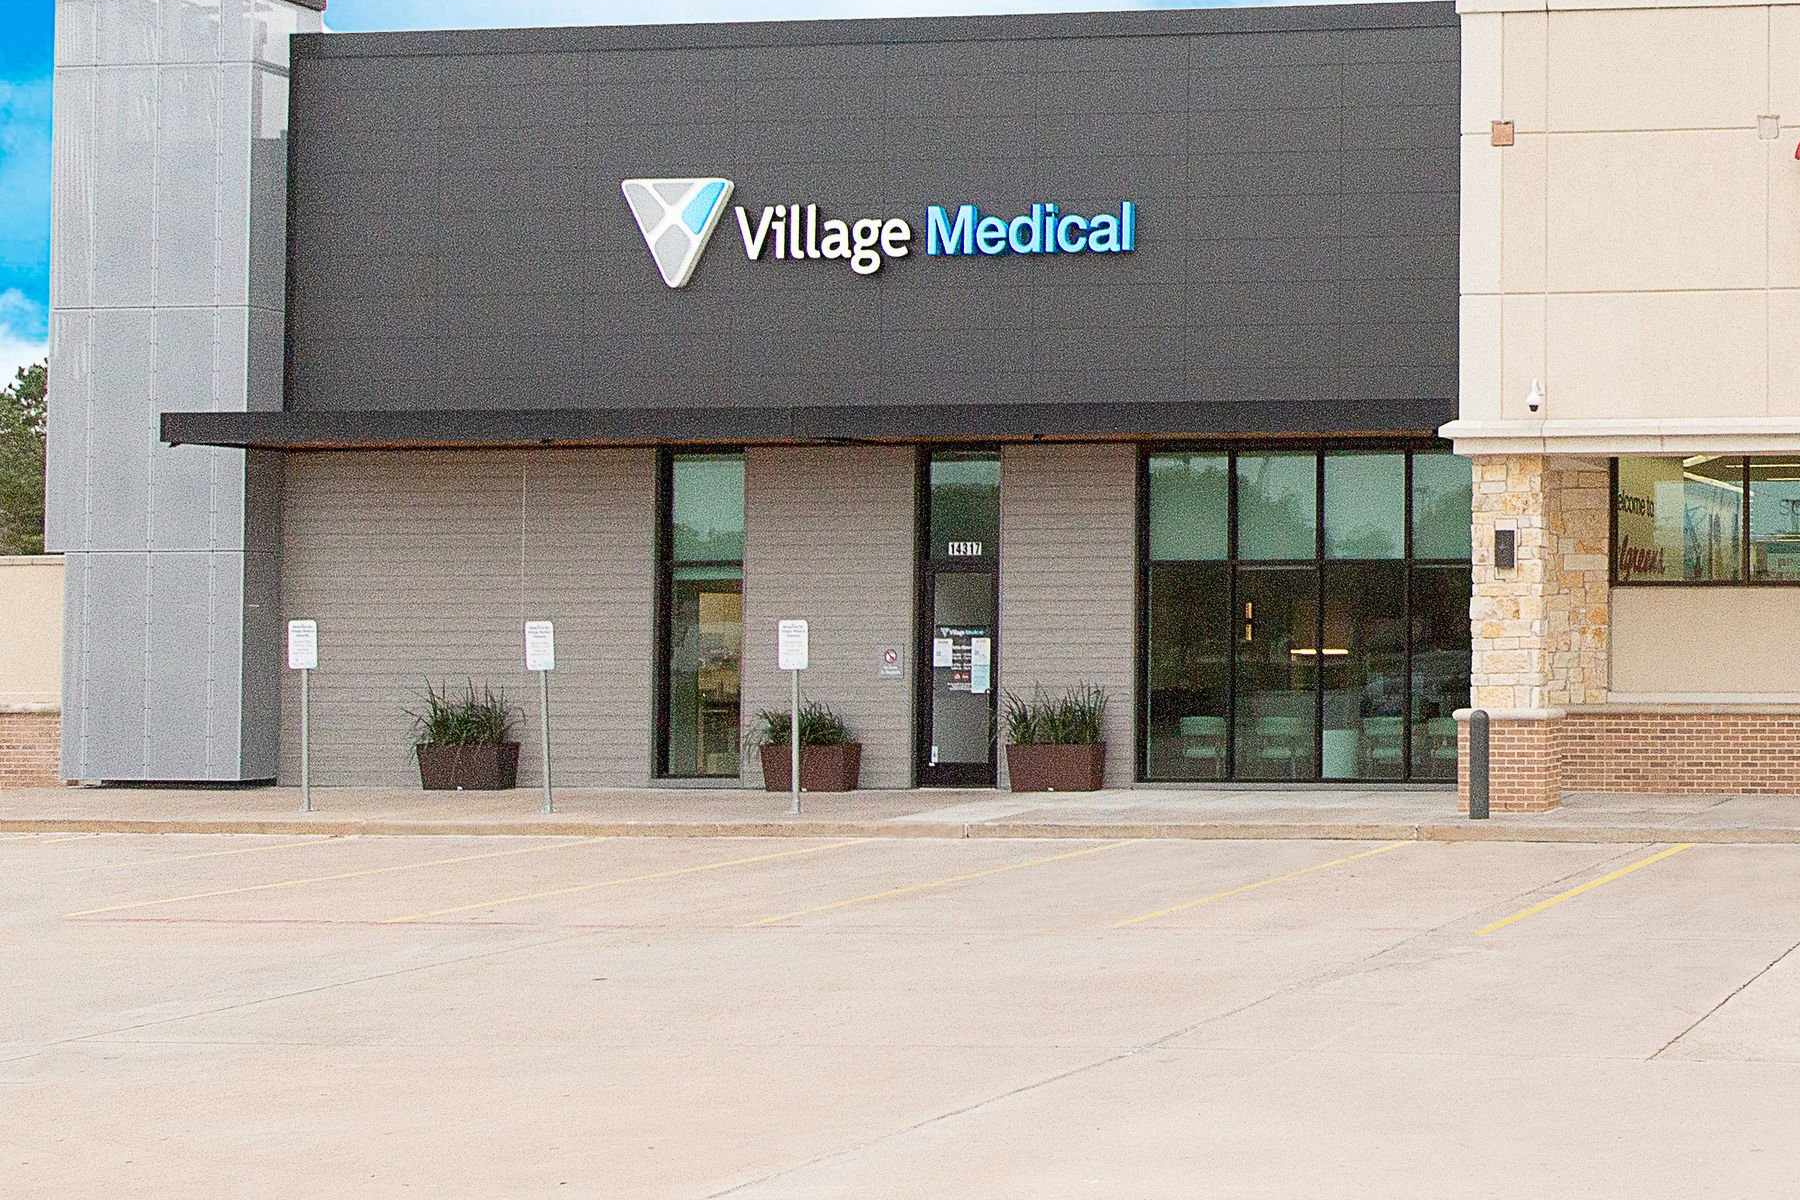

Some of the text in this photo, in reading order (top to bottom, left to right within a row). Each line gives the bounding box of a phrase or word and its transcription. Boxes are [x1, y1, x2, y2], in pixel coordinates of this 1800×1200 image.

[734, 201, 1136, 274] Village Medical
[1617, 490, 1645, 516] elcome
[950, 542, 981, 555] 14317
[1618, 534, 1666, 581] lgreens
